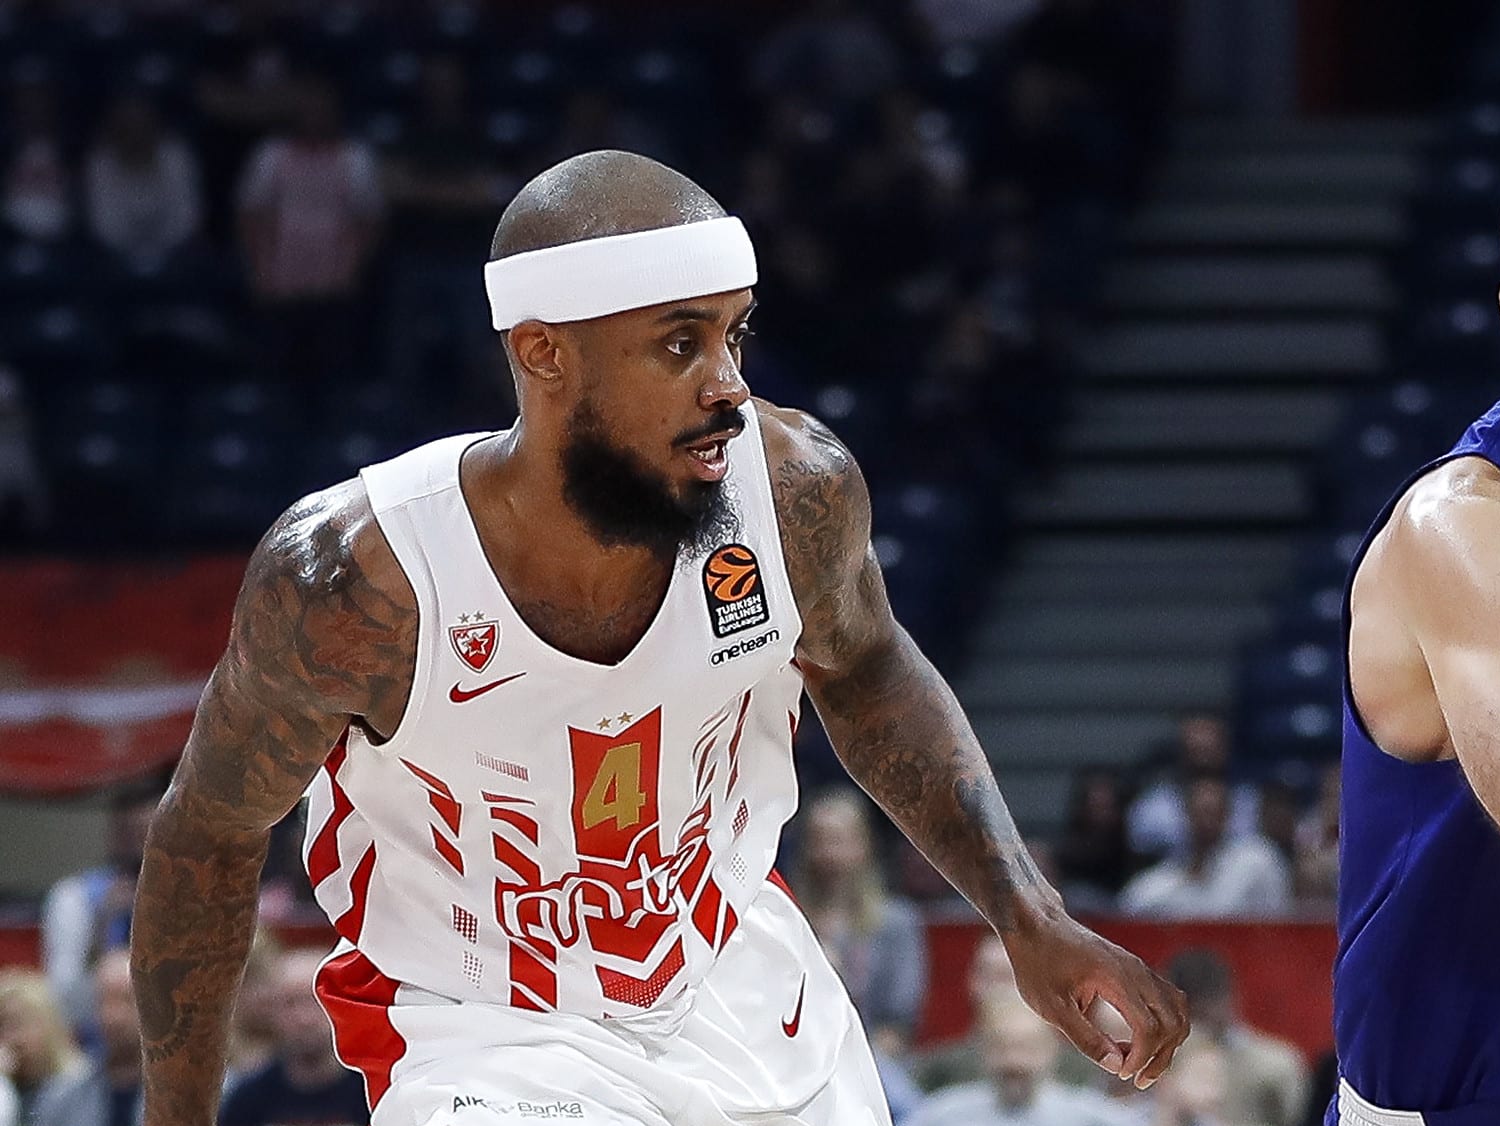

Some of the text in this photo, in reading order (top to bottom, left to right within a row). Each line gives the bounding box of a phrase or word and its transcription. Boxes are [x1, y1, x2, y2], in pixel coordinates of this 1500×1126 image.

[715, 594, 762, 617] TURKISH
[718, 604, 763, 625] AIRLINES
[582, 742, 648, 831] 4
[517, 1101, 583, 1115] Banka
